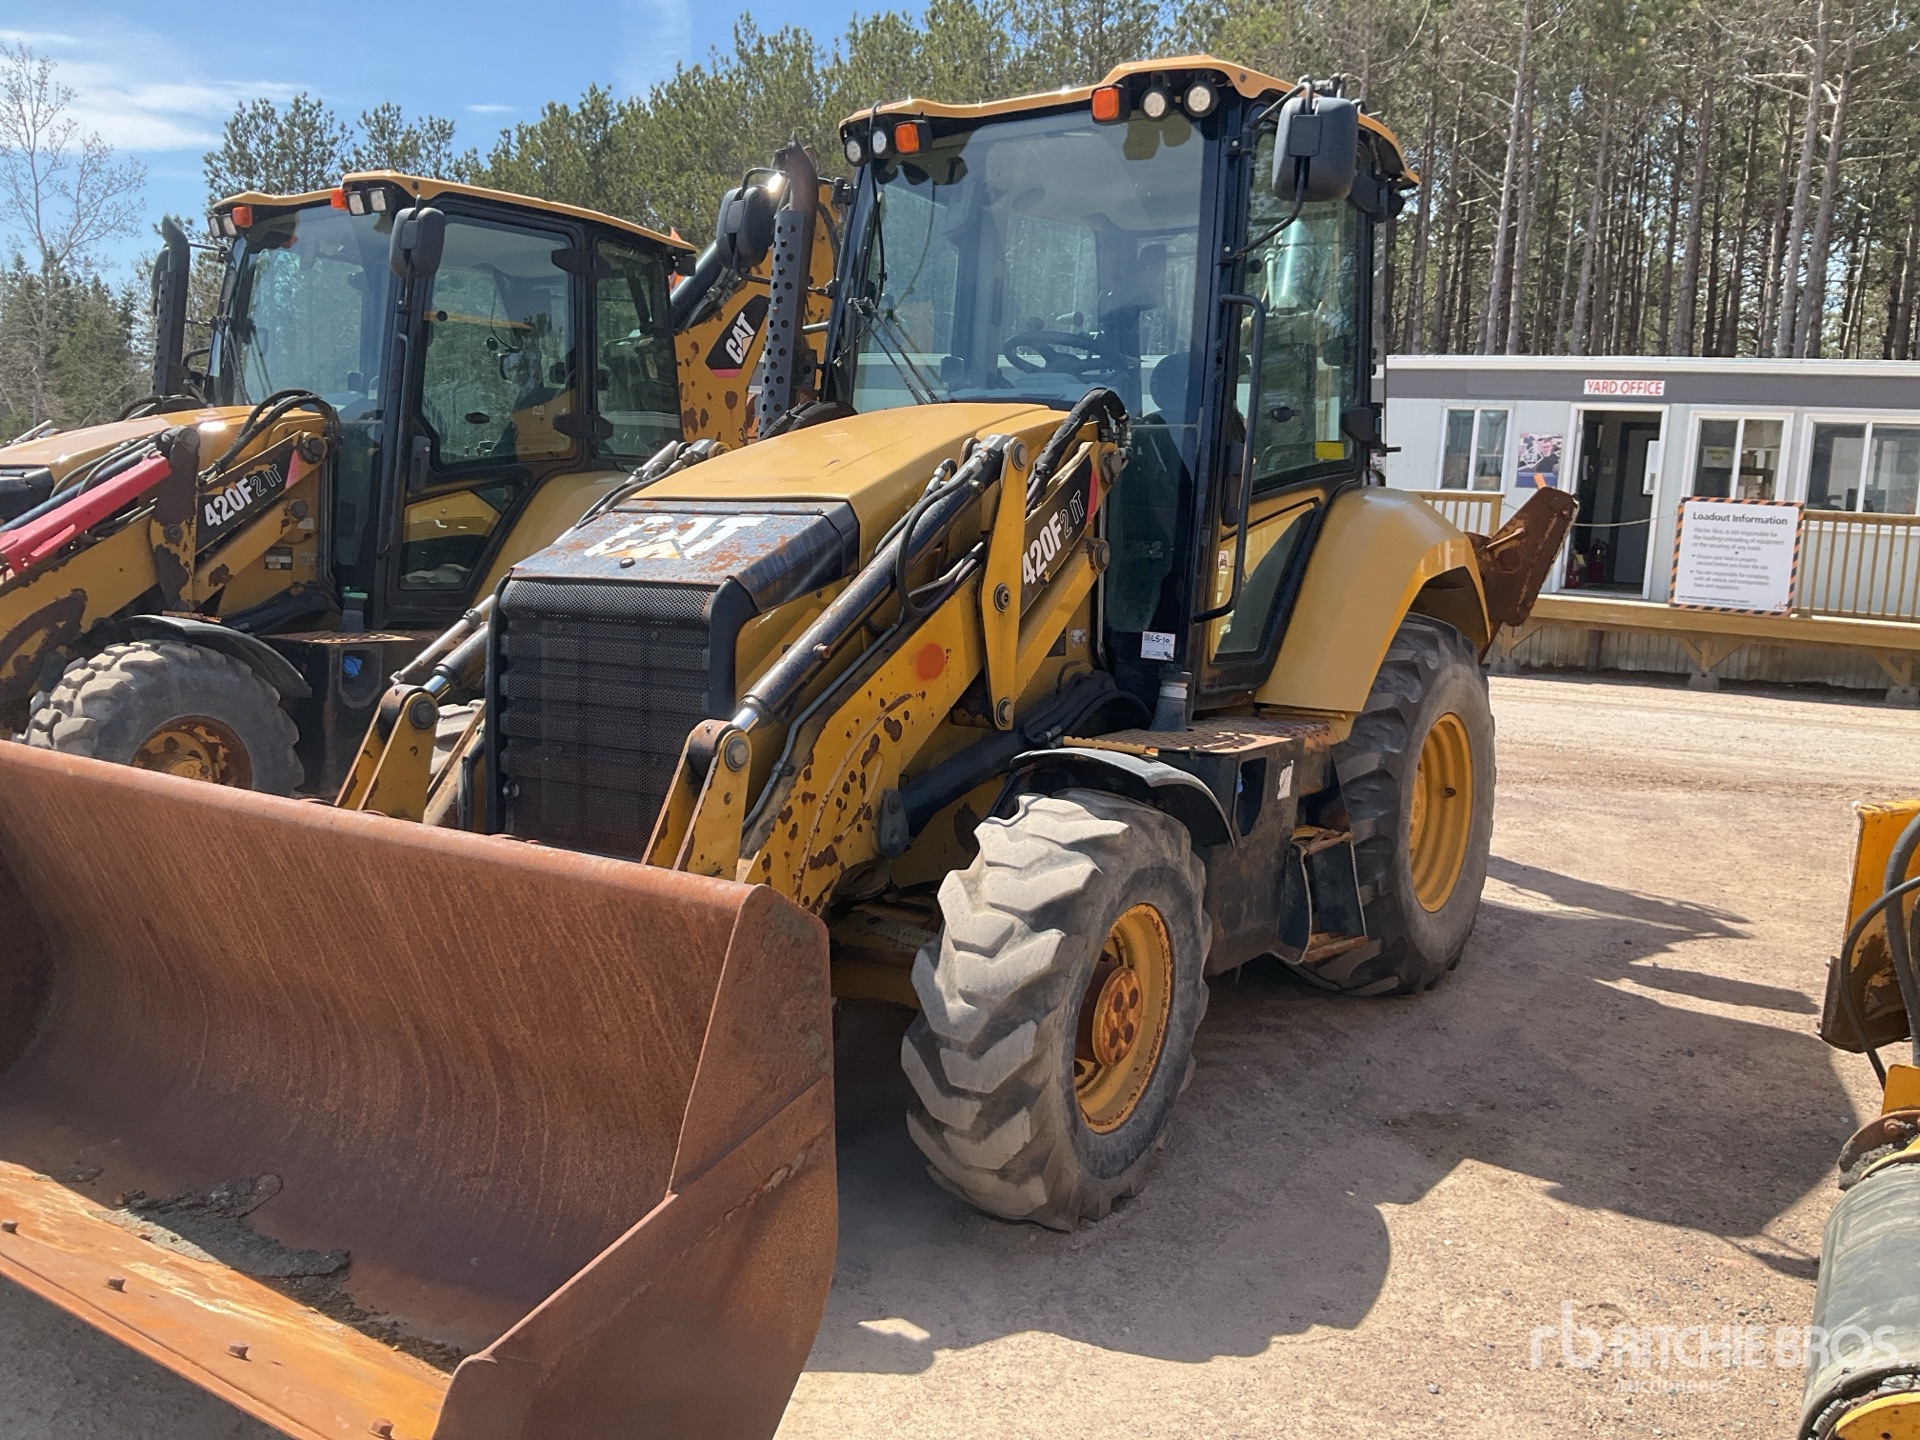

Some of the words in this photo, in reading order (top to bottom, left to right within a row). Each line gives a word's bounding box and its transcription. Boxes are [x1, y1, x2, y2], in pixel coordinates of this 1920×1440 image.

[725, 312, 756, 365] CAT
[1587, 381, 1618, 394] YARD
[1620, 381, 1662, 395] OFFICE
[1692, 512, 1730, 522] Loadout
[1732, 514, 1788, 526] Information
[584, 515, 768, 559] CAT
